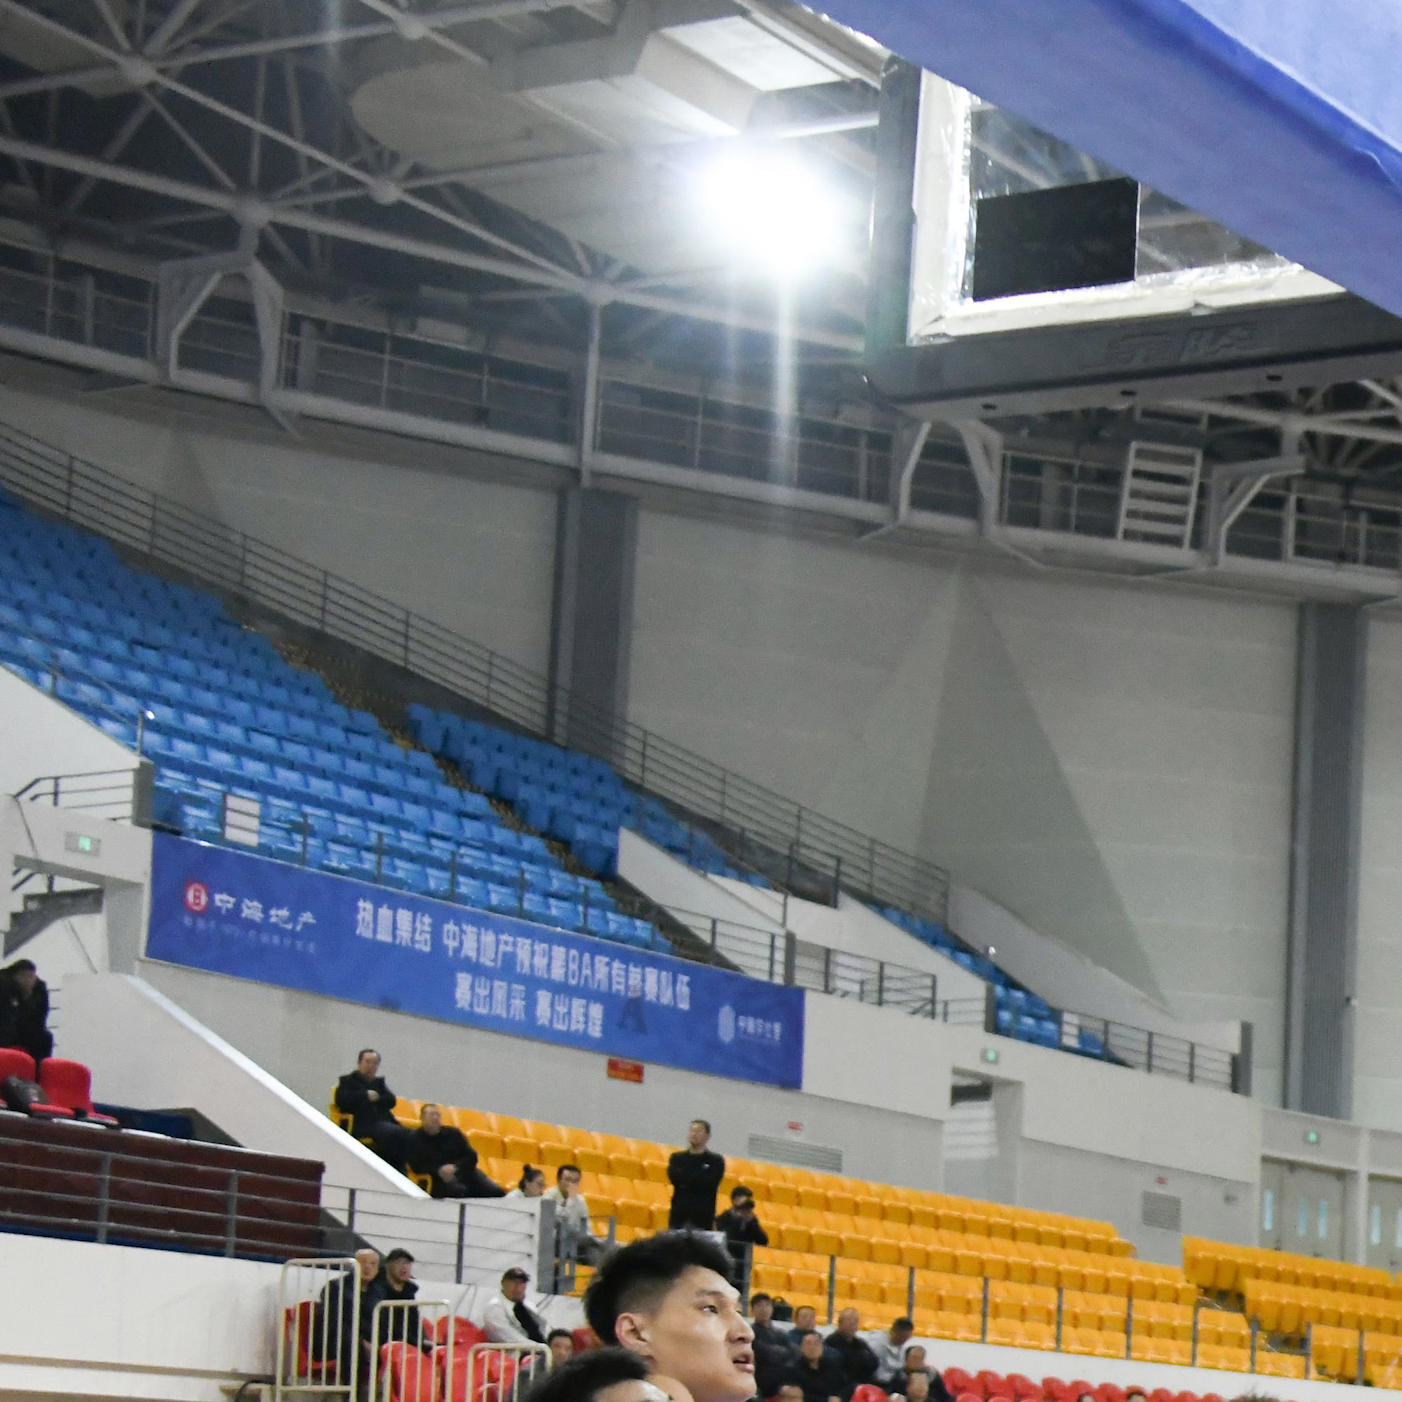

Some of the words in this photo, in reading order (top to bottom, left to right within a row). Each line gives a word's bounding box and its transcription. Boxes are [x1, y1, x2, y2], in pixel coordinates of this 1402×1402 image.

[213, 891, 317, 932] 中海地产
[356, 897, 433, 953] 热血集结
